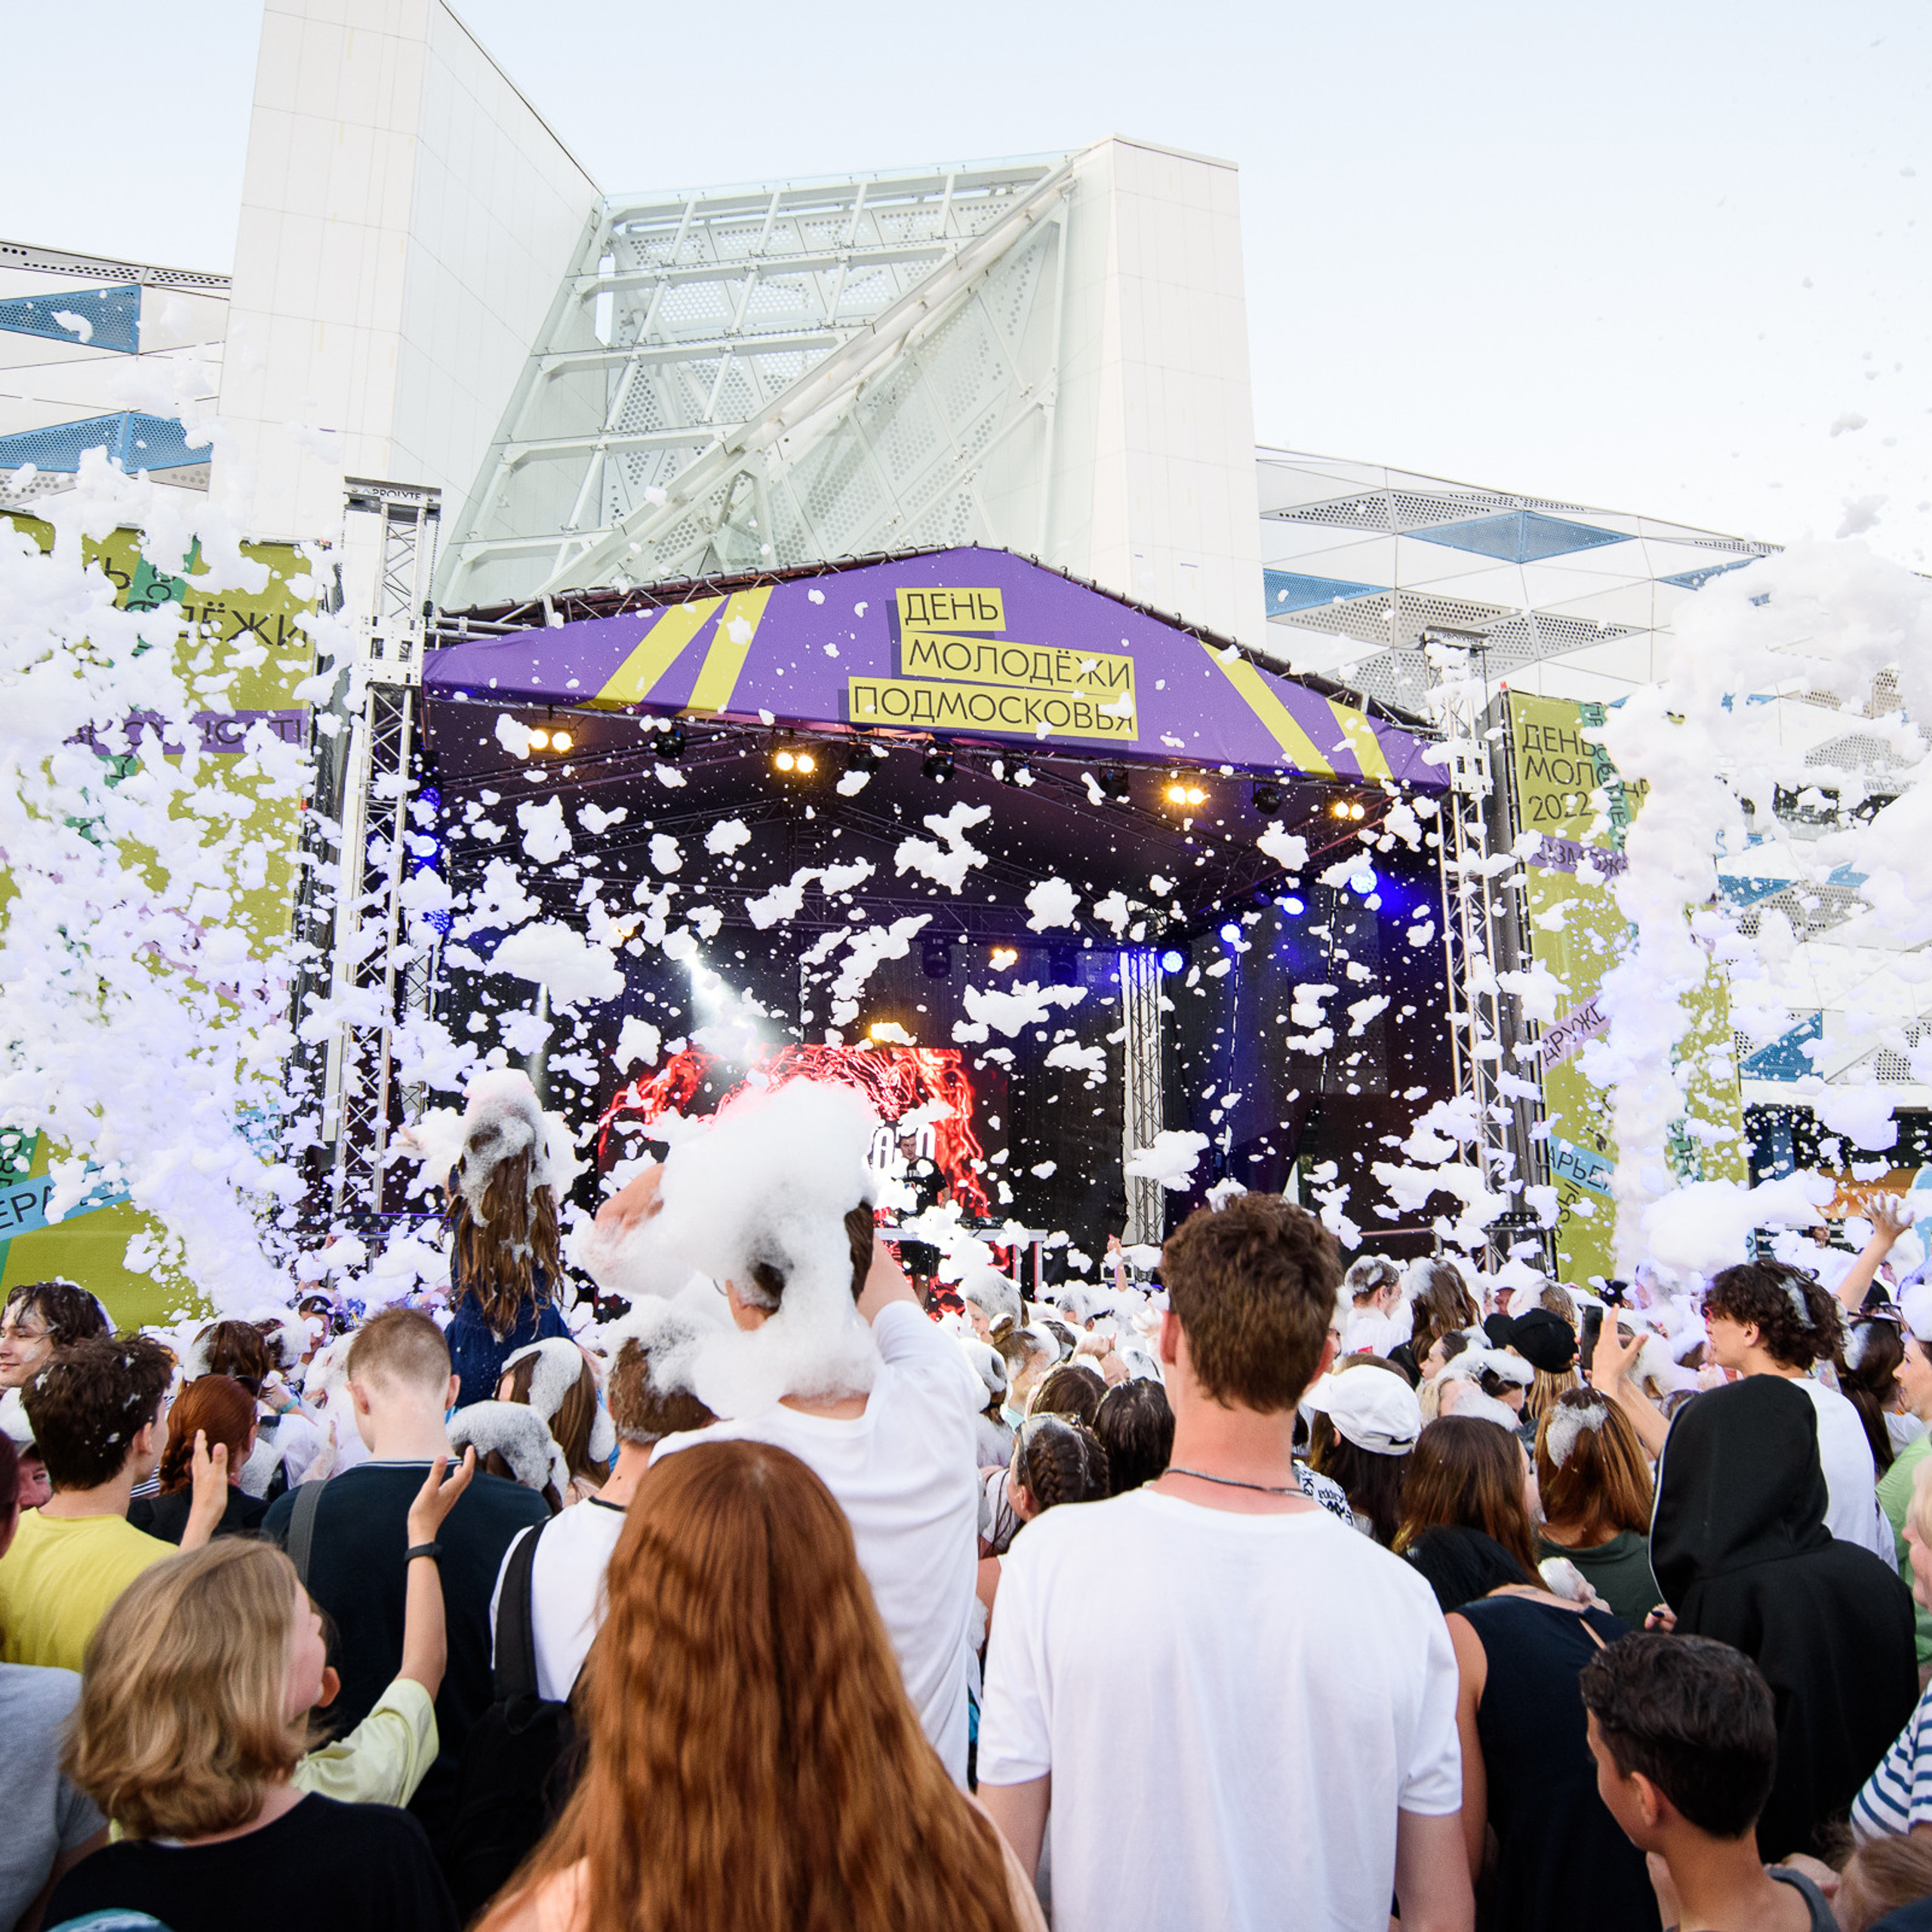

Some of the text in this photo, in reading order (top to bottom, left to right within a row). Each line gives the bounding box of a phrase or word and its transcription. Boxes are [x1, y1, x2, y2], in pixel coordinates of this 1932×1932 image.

[905, 593, 998, 626] ДЕНЬ
[909, 639, 1130, 689] МОЛОДЁЖИ
[1522, 724, 1597, 757] ДЕНЬ
